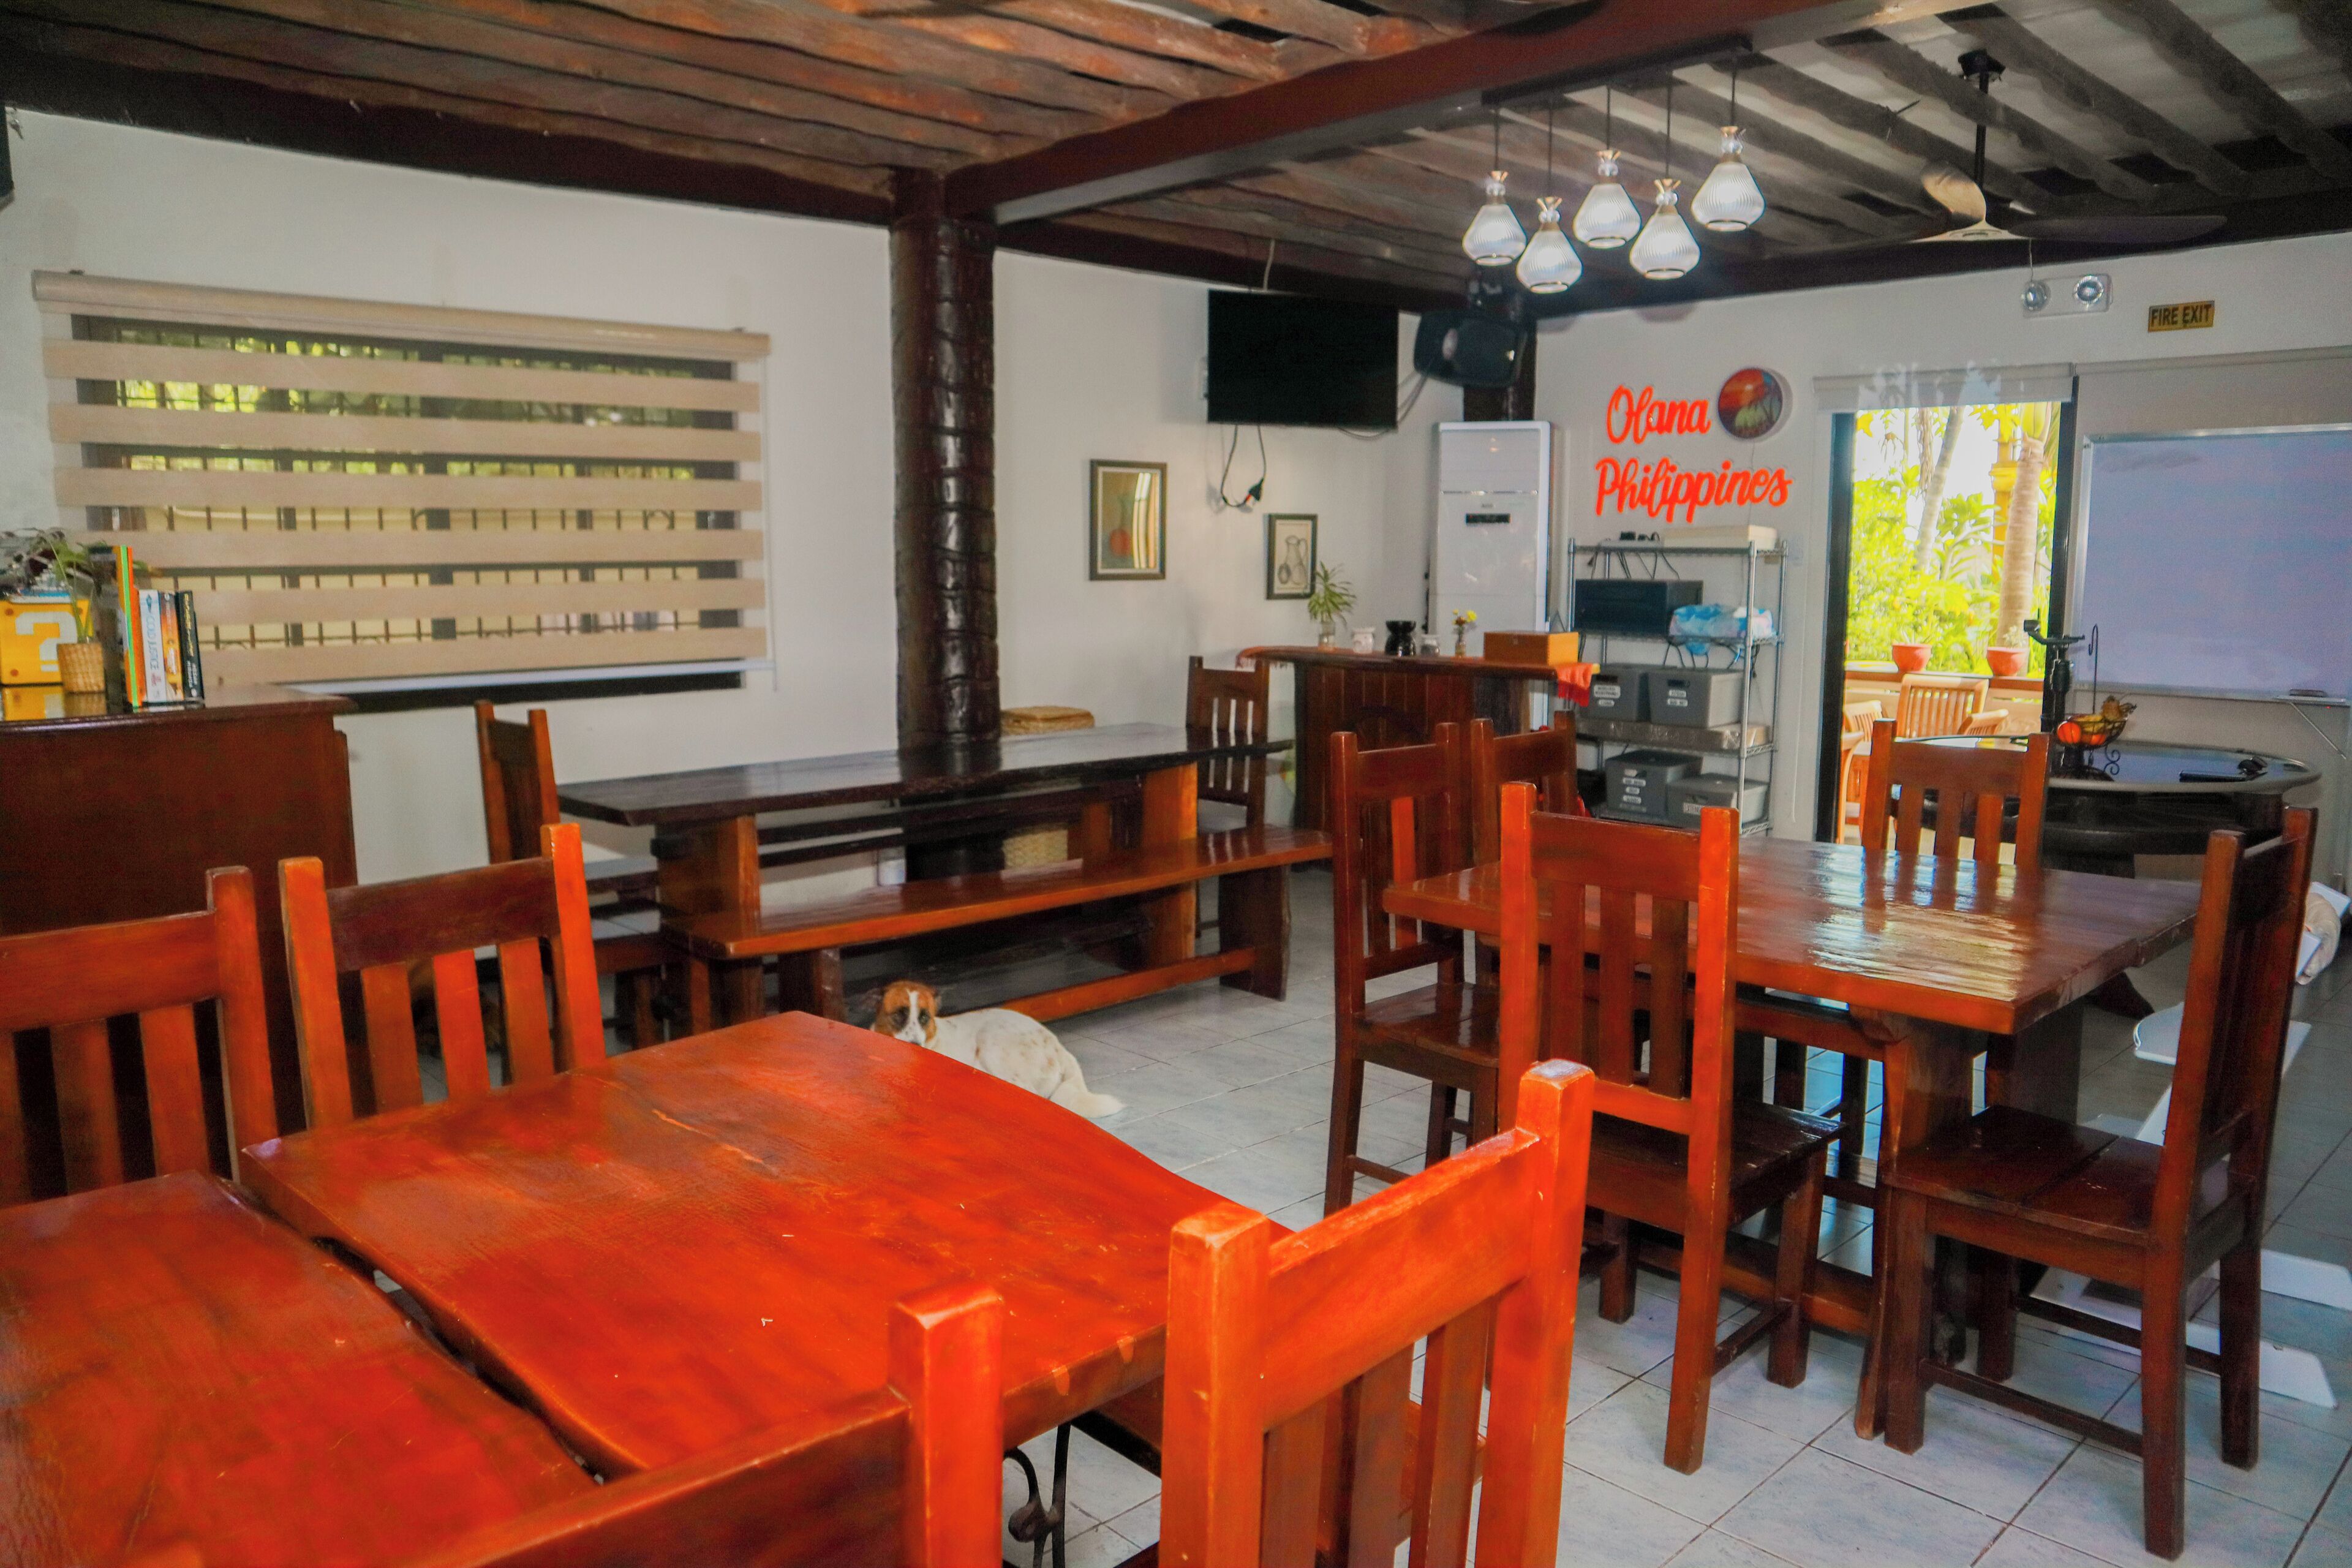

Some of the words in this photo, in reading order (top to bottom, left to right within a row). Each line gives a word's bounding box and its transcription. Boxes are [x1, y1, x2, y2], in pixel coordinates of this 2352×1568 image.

[2150, 306, 2179, 326] FIRE
[2182, 304, 2212, 324] EXIT
[1607, 385, 1711, 445] Olana
[1595, 457, 1793, 523] Philippines
